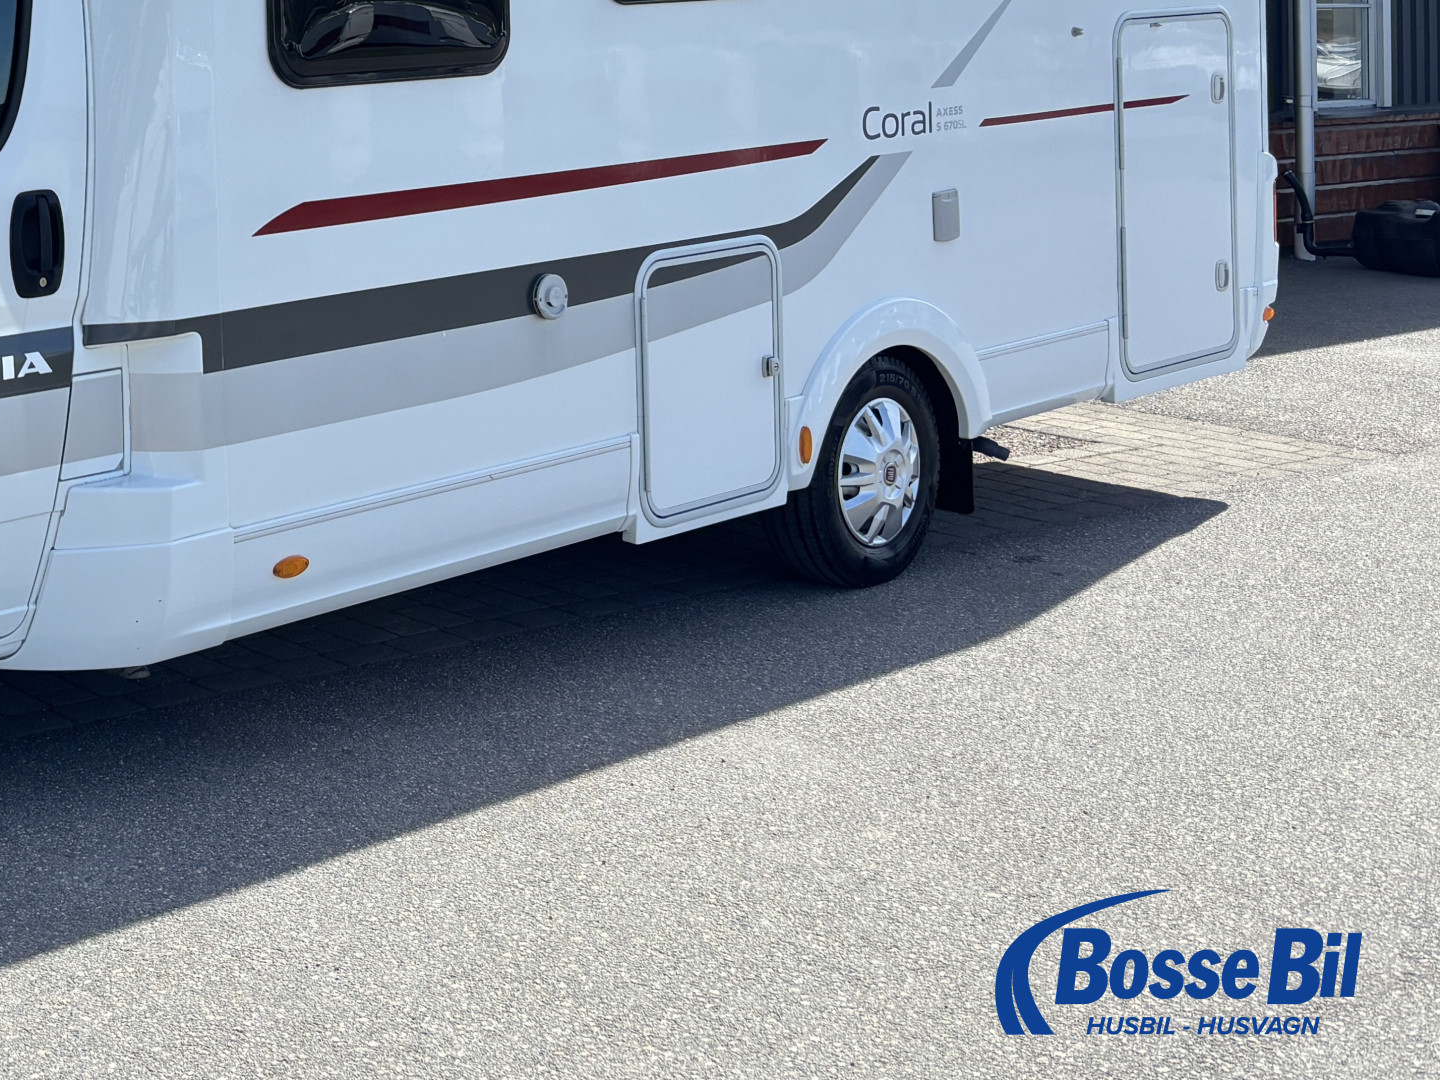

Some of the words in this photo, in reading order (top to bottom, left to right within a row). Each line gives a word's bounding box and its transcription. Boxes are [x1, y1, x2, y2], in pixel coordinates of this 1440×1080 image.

[862, 101, 933, 140] Coral
[936, 106, 964, 118] AXESS
[879, 372, 911, 390] 215/70
